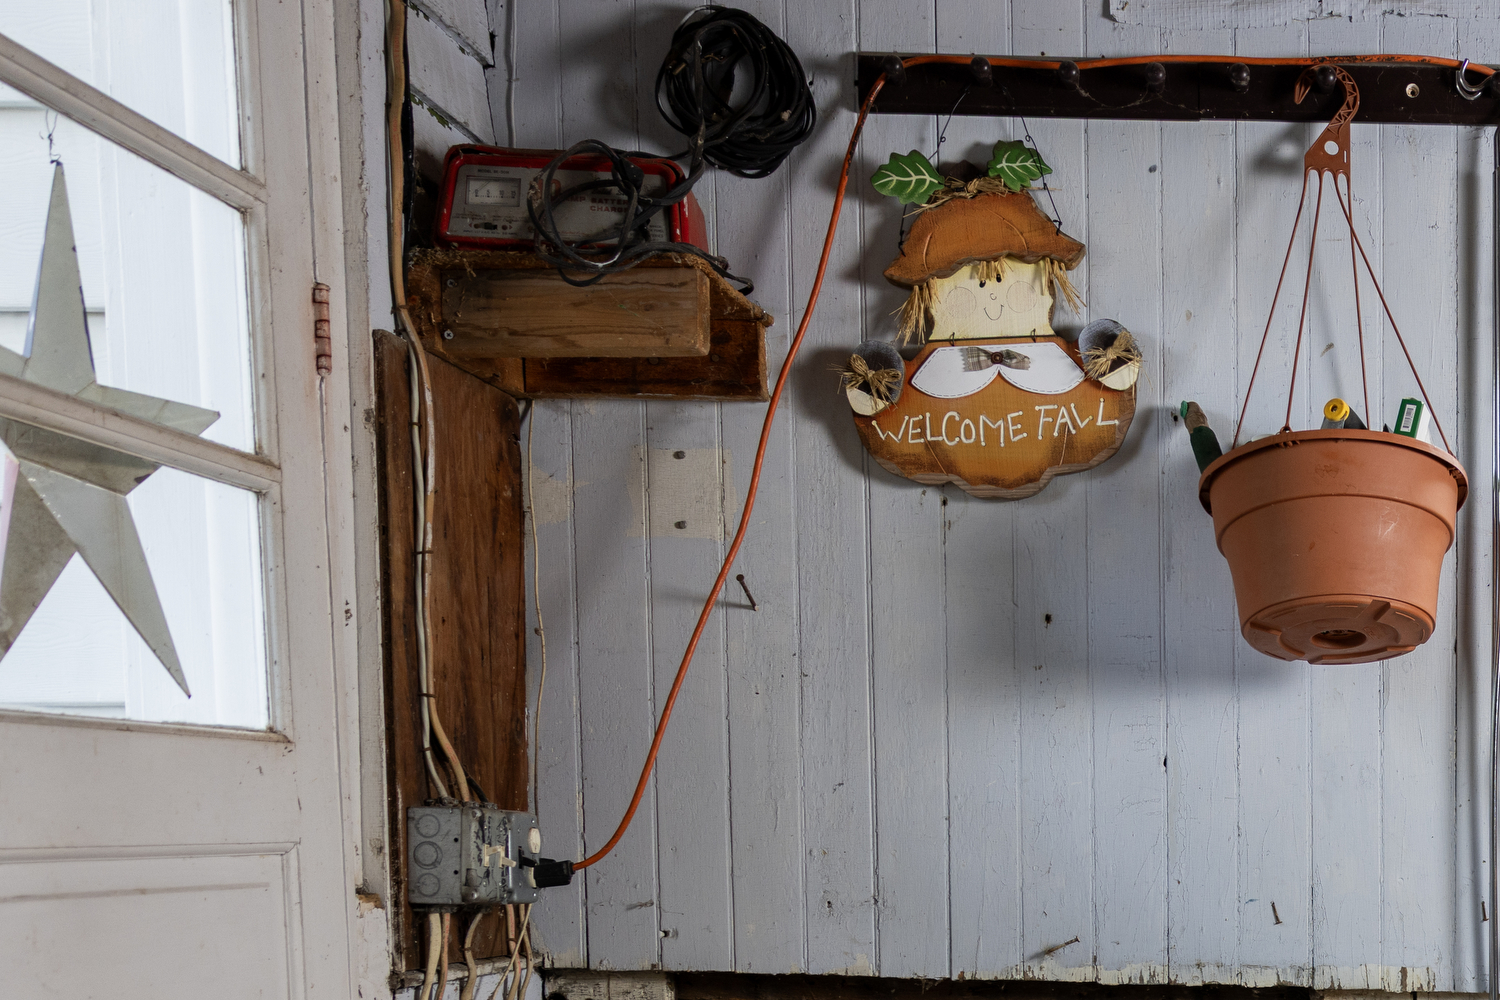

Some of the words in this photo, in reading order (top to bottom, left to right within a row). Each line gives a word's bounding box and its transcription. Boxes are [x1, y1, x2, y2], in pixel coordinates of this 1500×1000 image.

[590, 205, 628, 213] CHARG
[872, 411, 1028, 448] WELCOME
[1035, 398, 1119, 440] FALL
